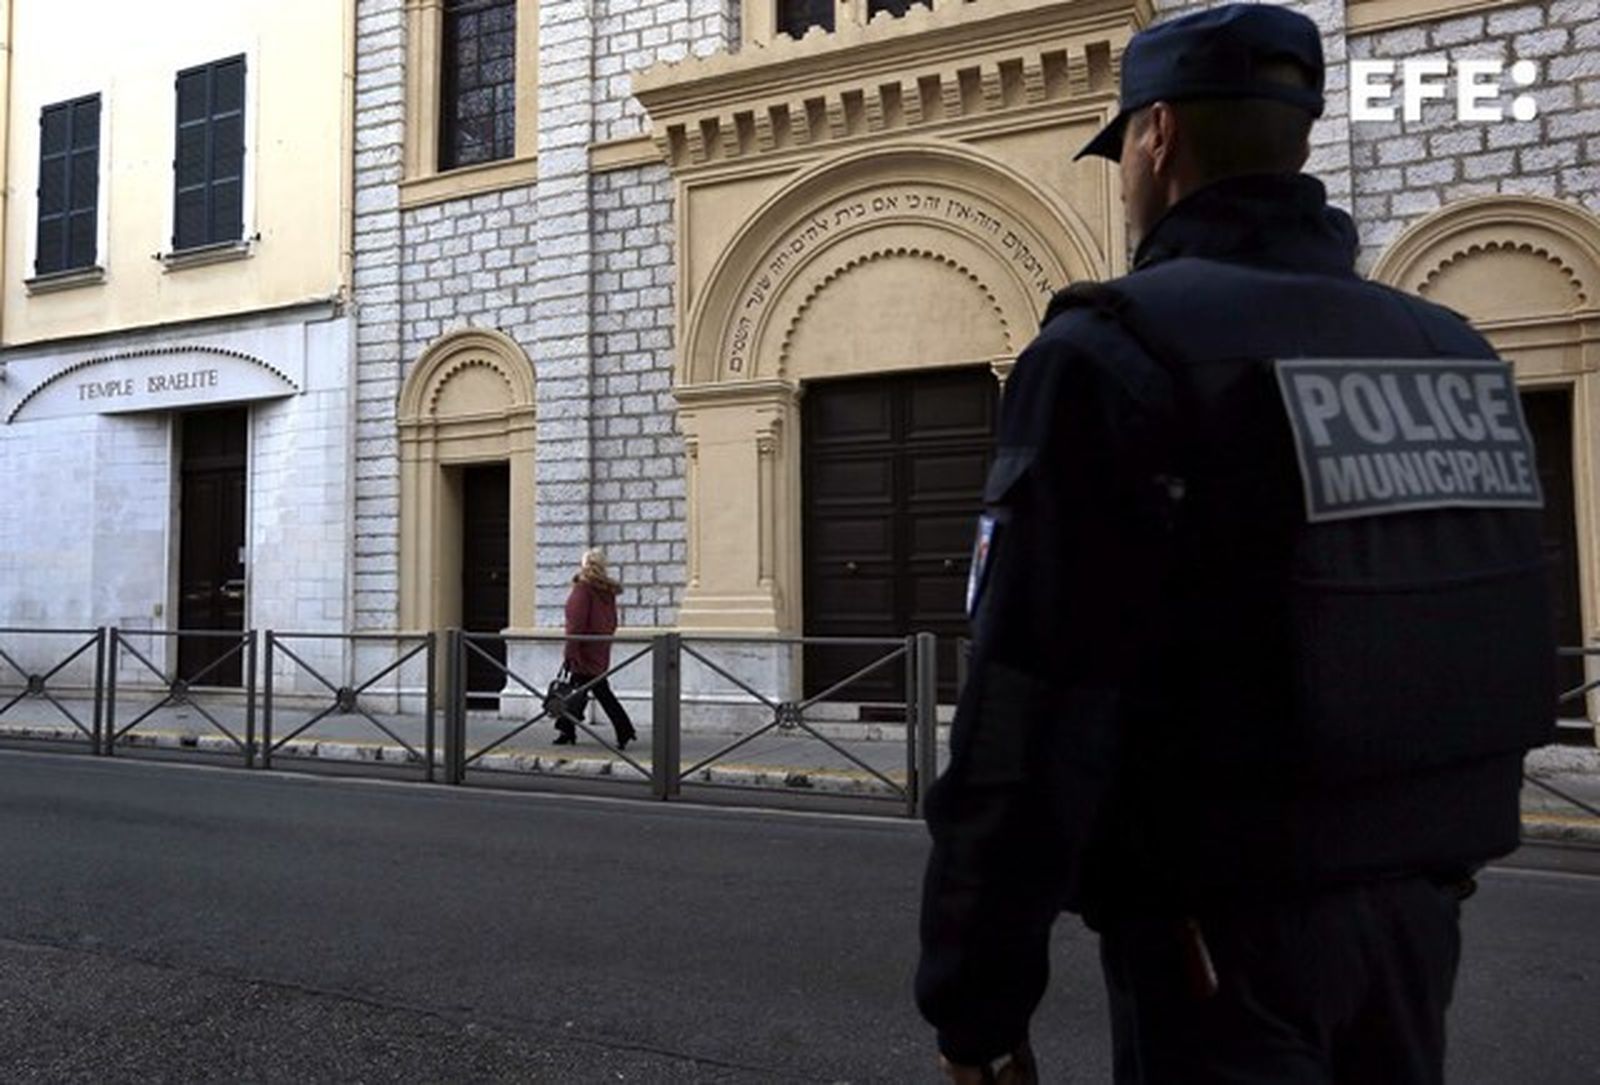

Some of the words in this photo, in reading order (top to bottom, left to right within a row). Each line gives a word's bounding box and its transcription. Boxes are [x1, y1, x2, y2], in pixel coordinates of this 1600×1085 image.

[834, 203, 866, 226] בית
[873, 196, 898, 212] אם
[729, 316, 752, 373] השמים
[79, 379, 133, 400] TEMPLE
[147, 369, 218, 393] ISRAELITE
[1293, 372, 1521, 447] POLICE
[1317, 450, 1533, 505] MUNICIPALE
